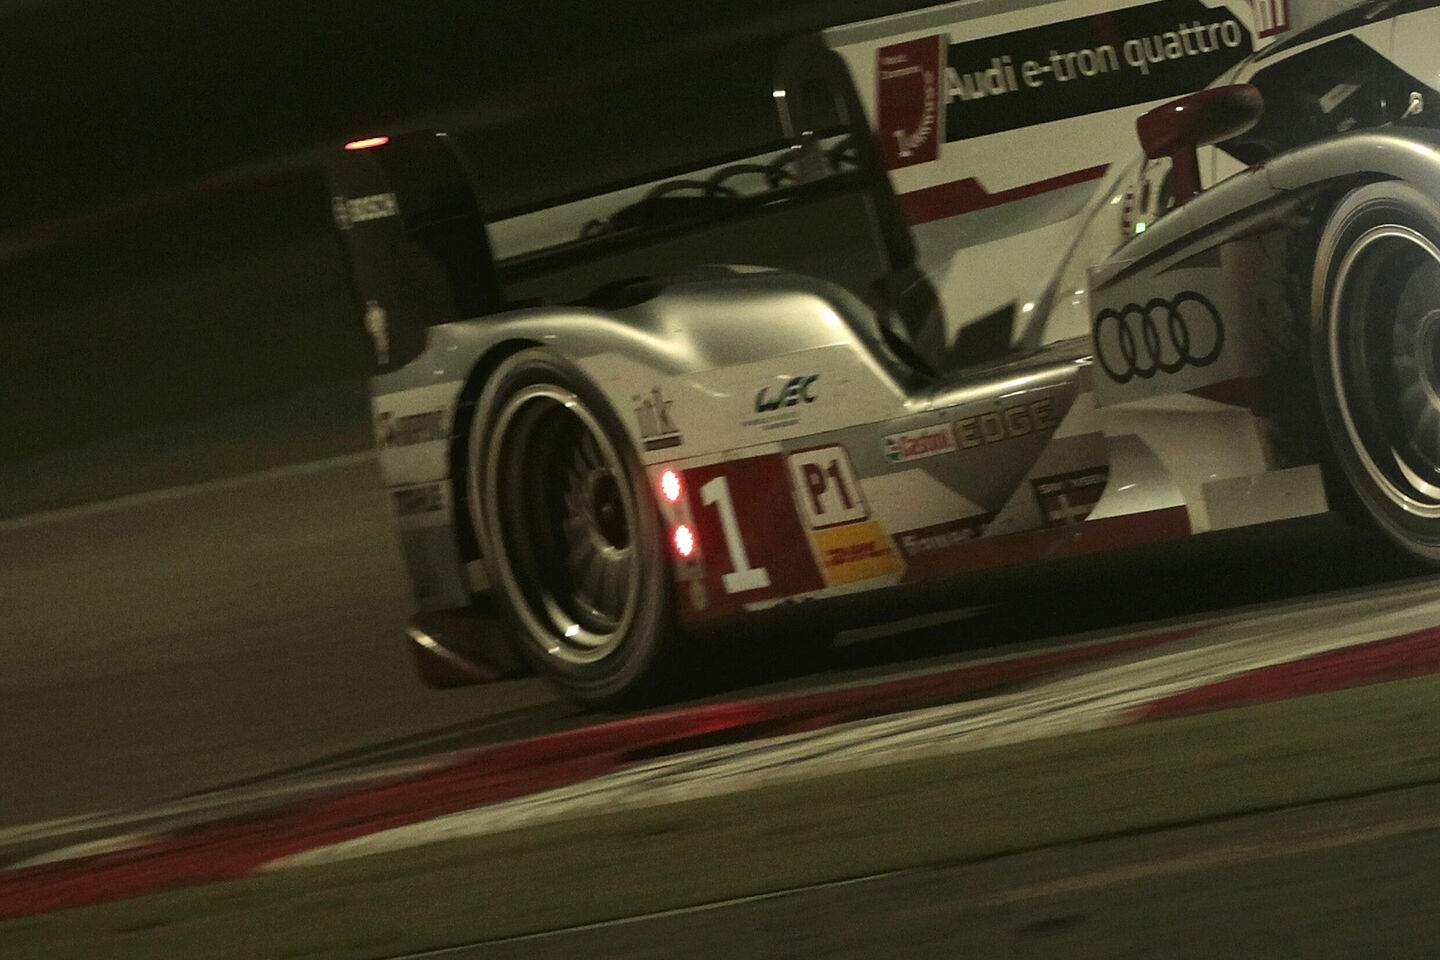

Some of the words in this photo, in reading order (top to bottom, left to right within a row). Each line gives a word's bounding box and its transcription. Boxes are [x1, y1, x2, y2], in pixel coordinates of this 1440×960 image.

[944, 54, 1019, 105] Audi
[1021, 43, 1121, 88] e-tron
[1123, 19, 1242, 76] quattro
[954, 398, 1052, 449] EDGE
[801, 458, 854, 515] P1
[699, 475, 772, 594] 1
